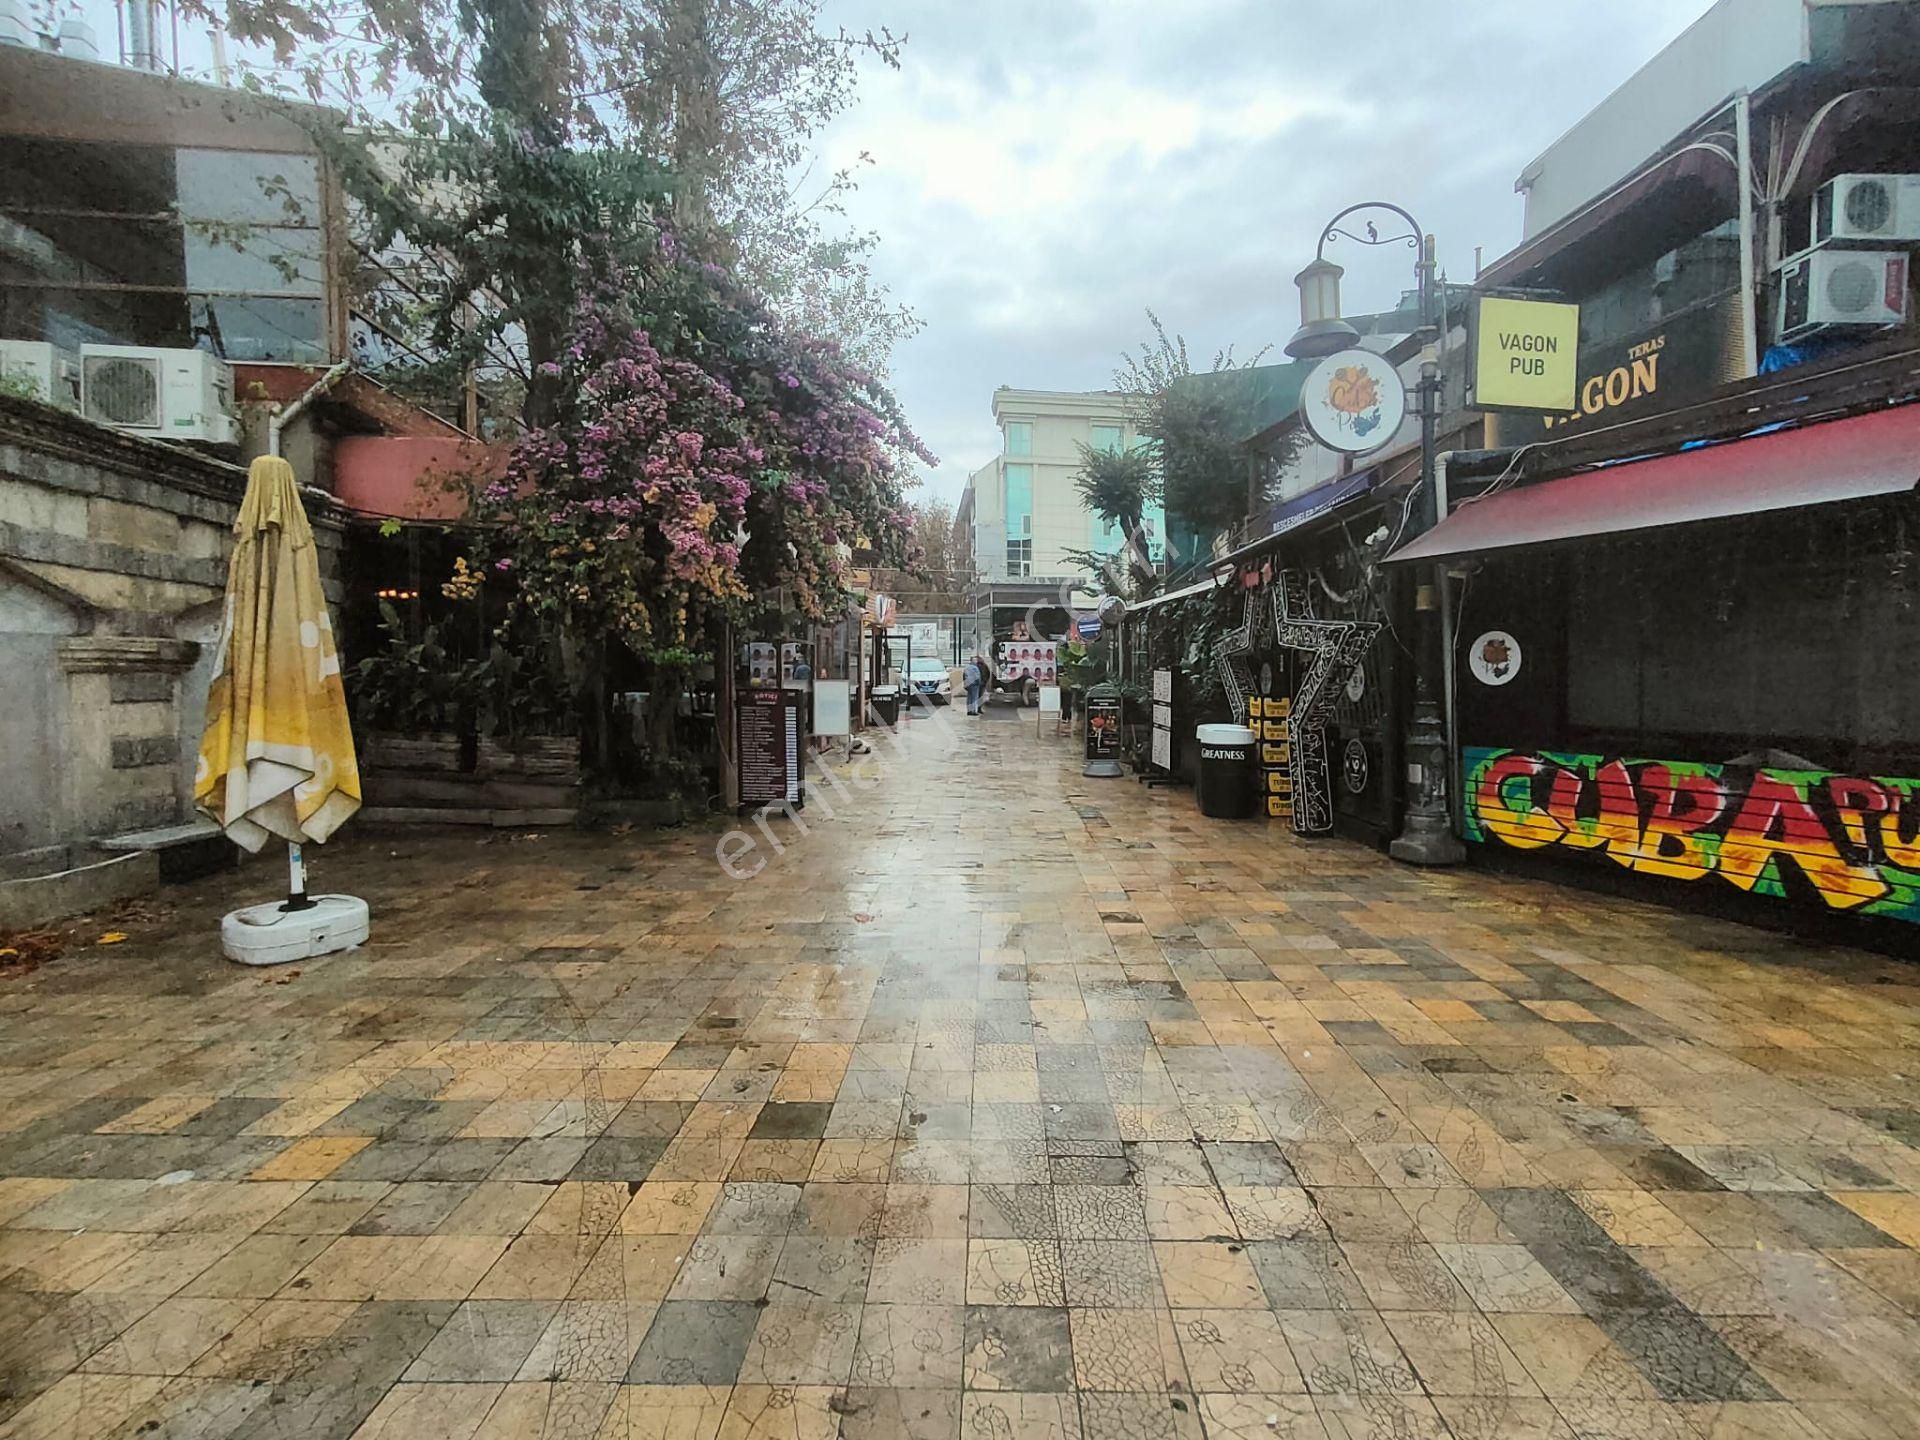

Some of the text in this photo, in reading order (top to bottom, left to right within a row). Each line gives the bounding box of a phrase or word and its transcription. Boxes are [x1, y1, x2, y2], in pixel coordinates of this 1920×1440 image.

[1499, 333, 1558, 353] VAGON
[1628, 335, 1665, 359] TERAS
[1510, 357, 1545, 376] PUB
[1201, 748, 1245, 760] GREATNESS
[1476, 754, 1889, 909] CUBA
